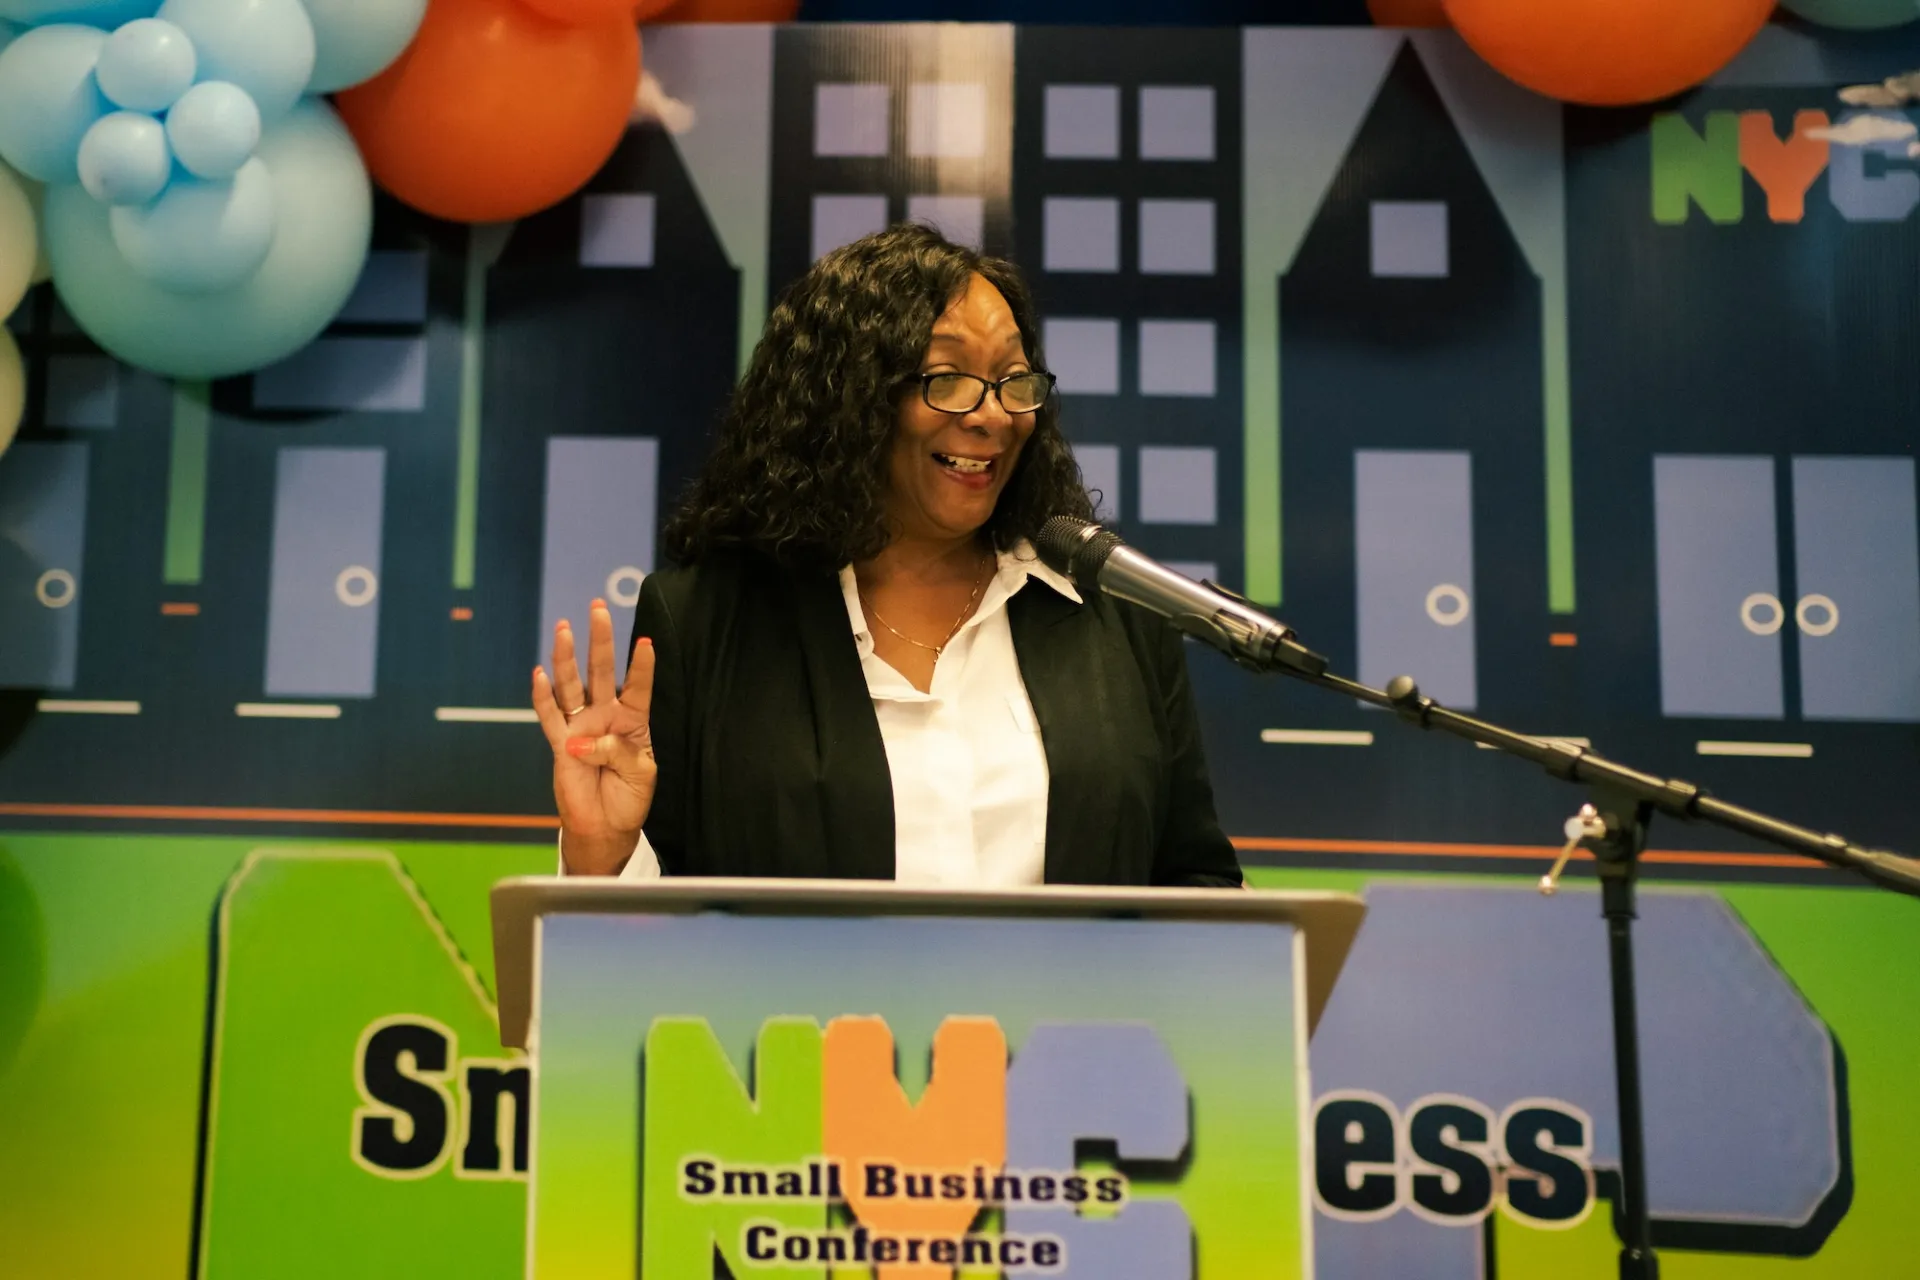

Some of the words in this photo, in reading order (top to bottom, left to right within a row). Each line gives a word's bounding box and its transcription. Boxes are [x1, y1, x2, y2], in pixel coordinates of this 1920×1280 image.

[1652, 109, 1919, 224] NYC
[644, 1015, 1192, 1280] NYC
[684, 1161, 841, 1197] Small
[865, 1165, 1122, 1202] Business
[745, 1226, 1060, 1267] Conference
